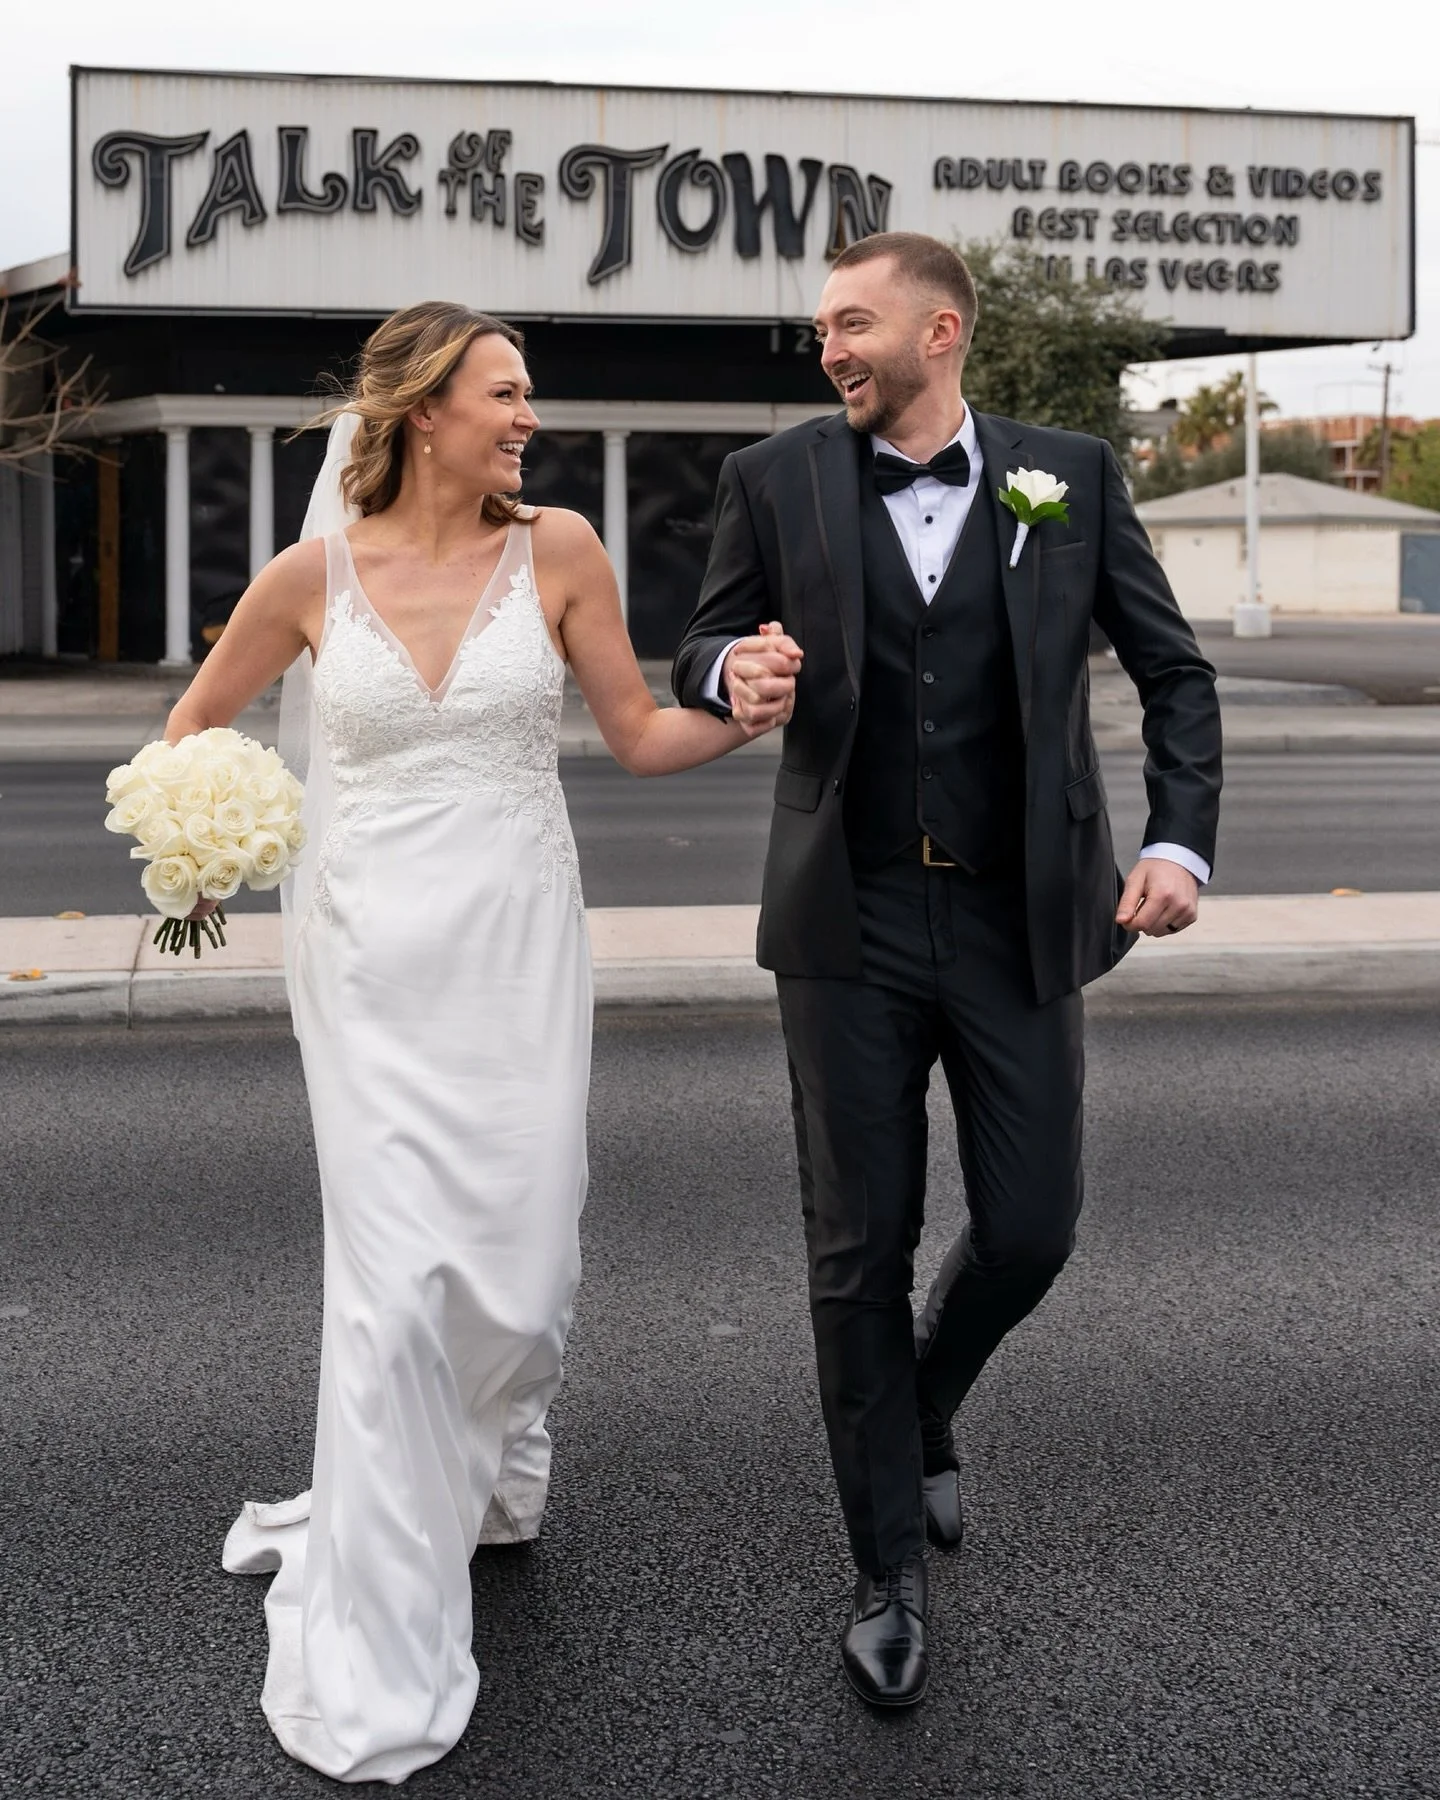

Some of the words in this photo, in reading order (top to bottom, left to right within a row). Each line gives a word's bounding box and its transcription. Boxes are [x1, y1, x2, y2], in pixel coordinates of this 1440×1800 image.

[448, 129, 512, 171] OF
[93, 125, 422, 277] TALK
[933, 156, 1047, 191] ADULT
[1058, 160, 1192, 194] BOOKS
[1205, 165, 1235, 198] &
[1247, 165, 1382, 202] VIDEOS
[439, 168, 545, 246] THE
[559, 143, 893, 286] TOWN
[1012, 206, 1099, 241] BEST
[1111, 209, 1298, 246] SELECTION
[1159, 257, 1282, 293] VEGAS
